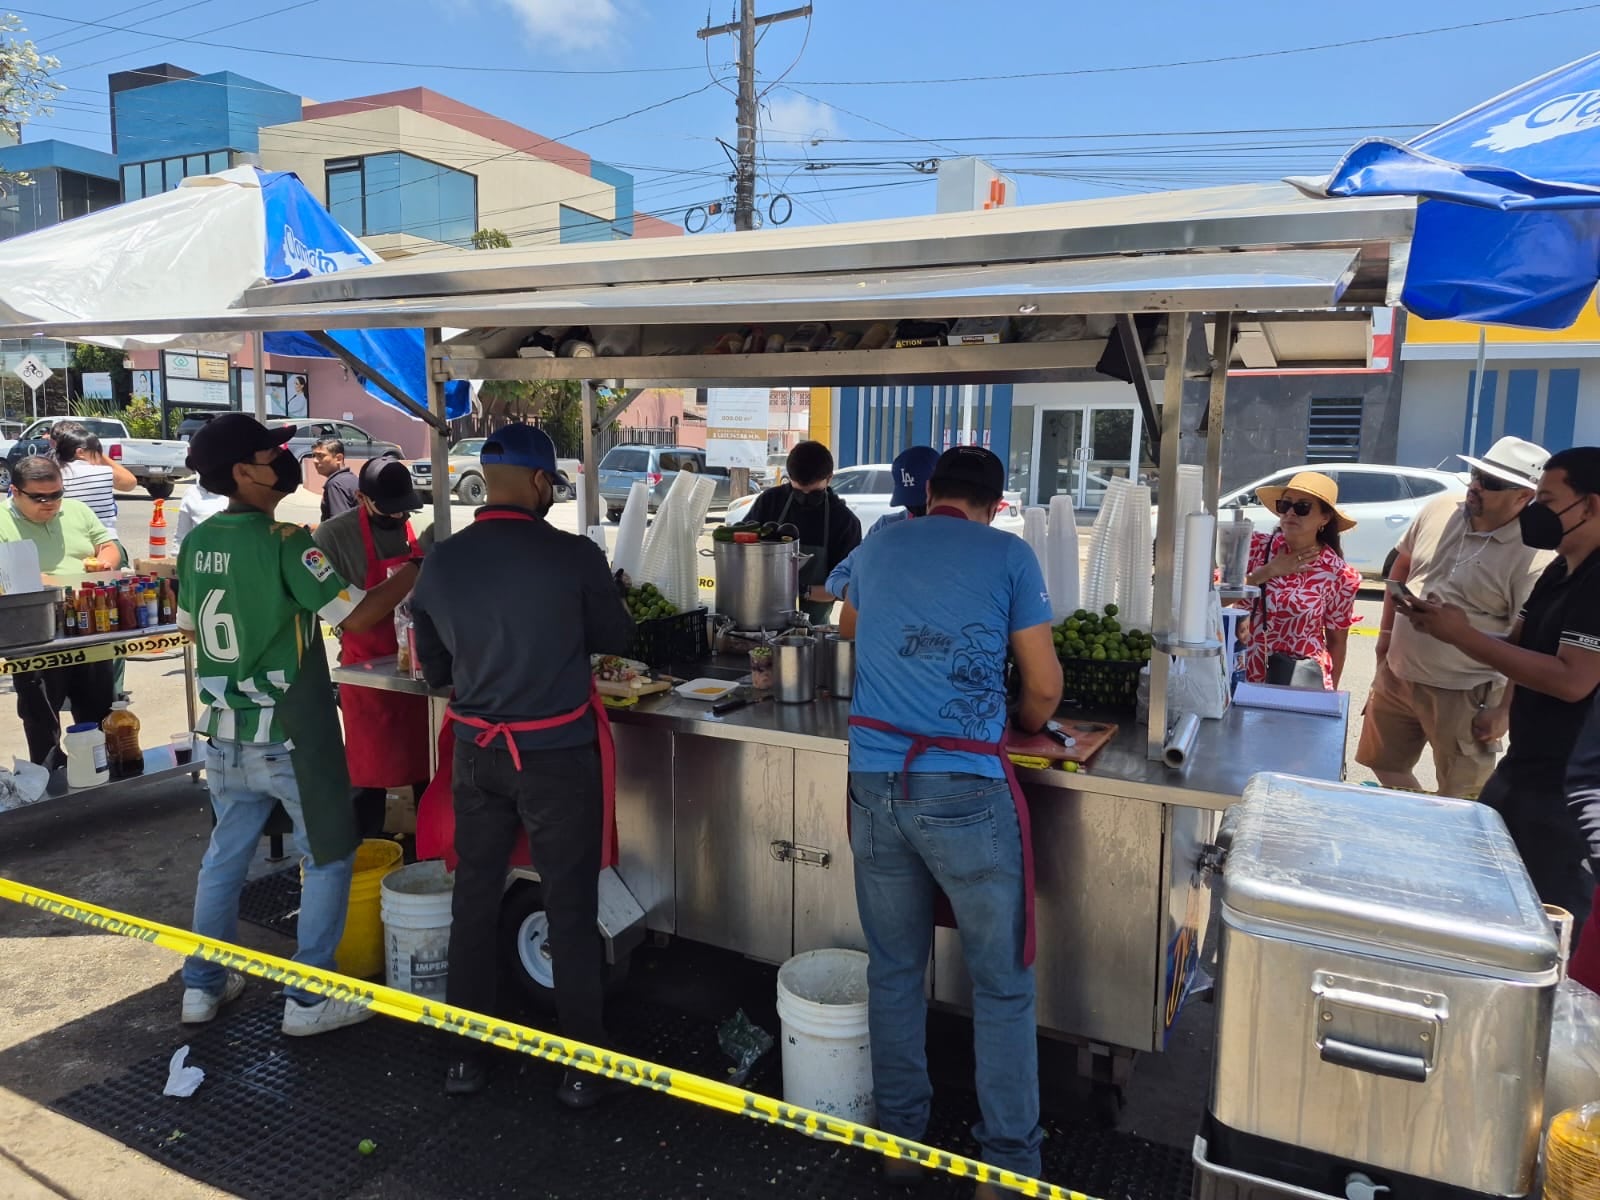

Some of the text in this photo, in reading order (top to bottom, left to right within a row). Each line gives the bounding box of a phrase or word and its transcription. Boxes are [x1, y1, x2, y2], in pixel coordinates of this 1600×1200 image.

[901, 468, 915, 487] LA
[195, 550, 231, 575] GABY
[198, 588, 240, 664] 6
[0, 650, 86, 674] PRECAU
